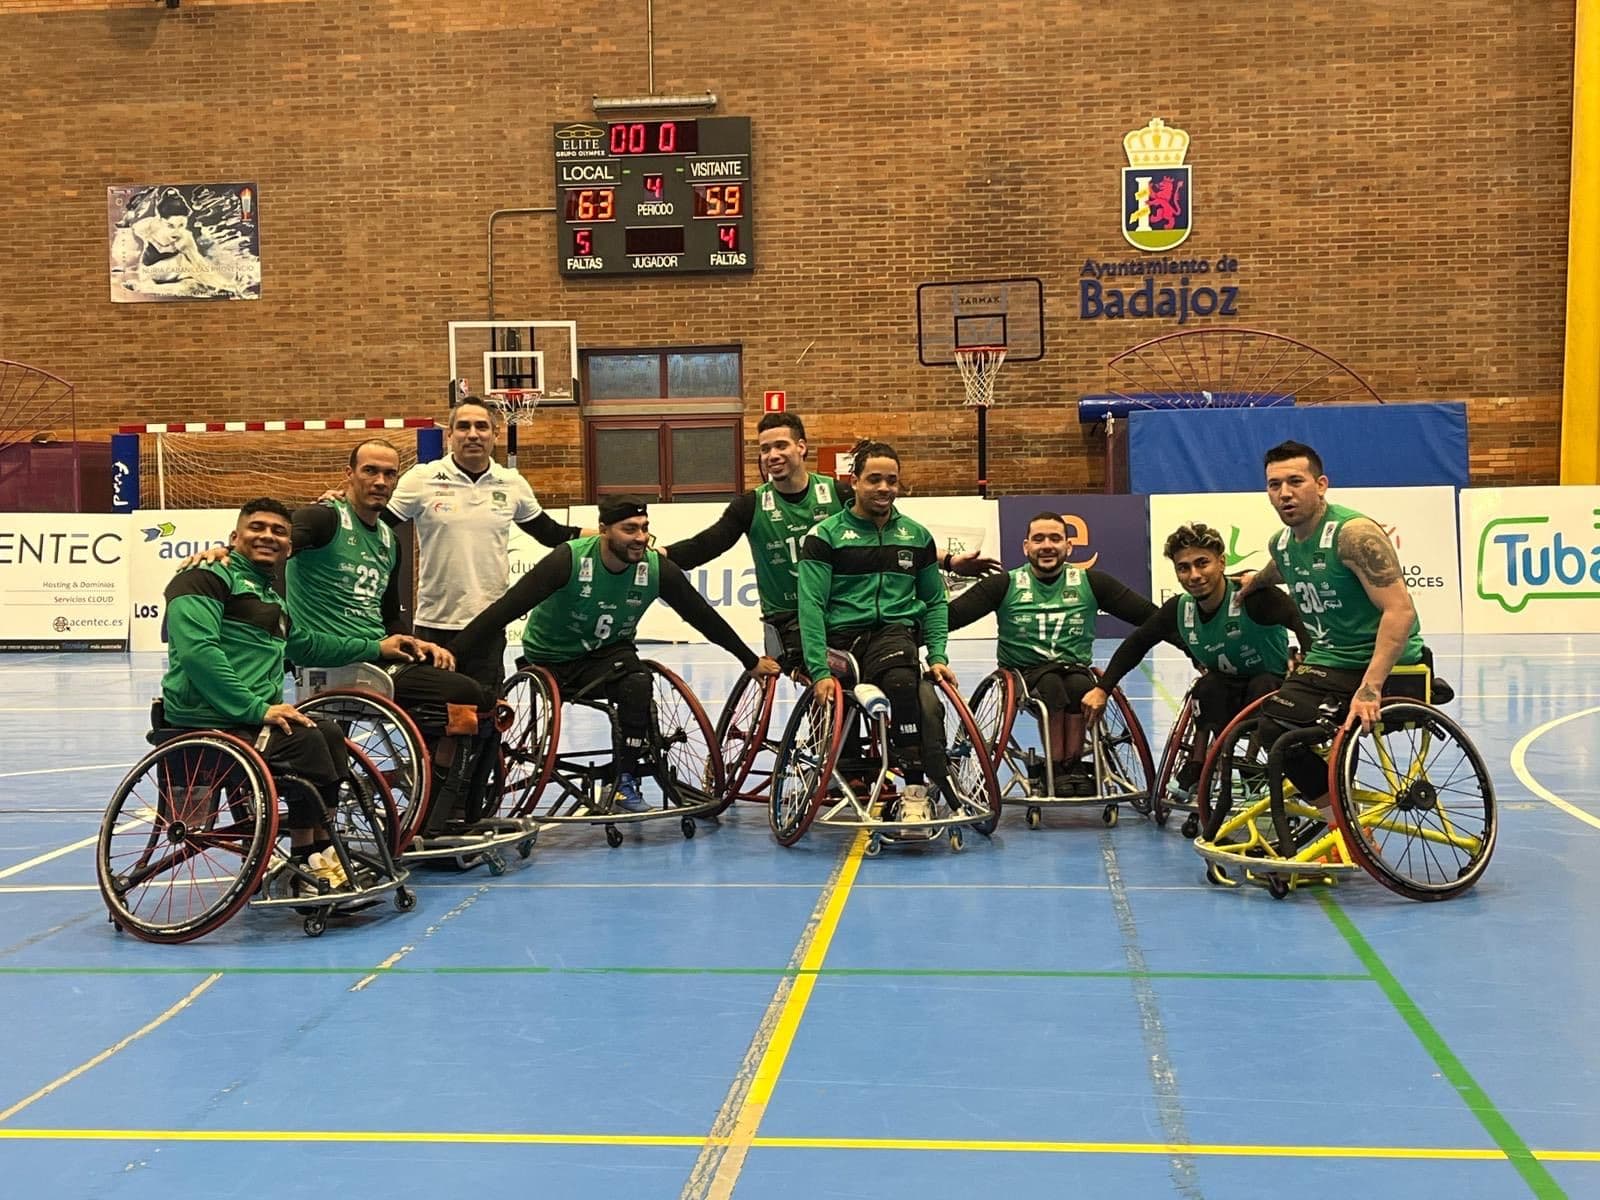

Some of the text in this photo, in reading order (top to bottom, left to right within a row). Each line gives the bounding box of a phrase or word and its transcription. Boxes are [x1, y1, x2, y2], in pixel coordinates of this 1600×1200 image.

[563, 139, 600, 150] ELITE
[563, 166, 614, 180] LOCAL
[691, 161, 741, 176] VISITANTE
[647, 178, 660, 198] 4
[578, 191, 614, 219] 63
[637, 203, 673, 216] PERIODO
[706, 186, 740, 215] 59
[576, 231, 589, 254] 5
[720, 228, 735, 248] 4
[567, 258, 603, 270] FALTAS
[632, 256, 678, 269] JUGADOR
[710, 253, 746, 266] FALTAS
[1081, 255, 1238, 278] Ayuntamiento de
[1080, 277, 1240, 324] Badajoz
[0, 533, 122, 564] ENTEC
[43, 581, 70, 590] Hosting
[354, 565, 379, 600] 23
[54, 595, 86, 603] Servicios
[1295, 582, 1324, 613] 30
[69, 618, 123, 627] acentec.es
[594, 614, 614, 639] 6
[1036, 612, 1066, 640] 17
[1218, 653, 1237, 675] 4
